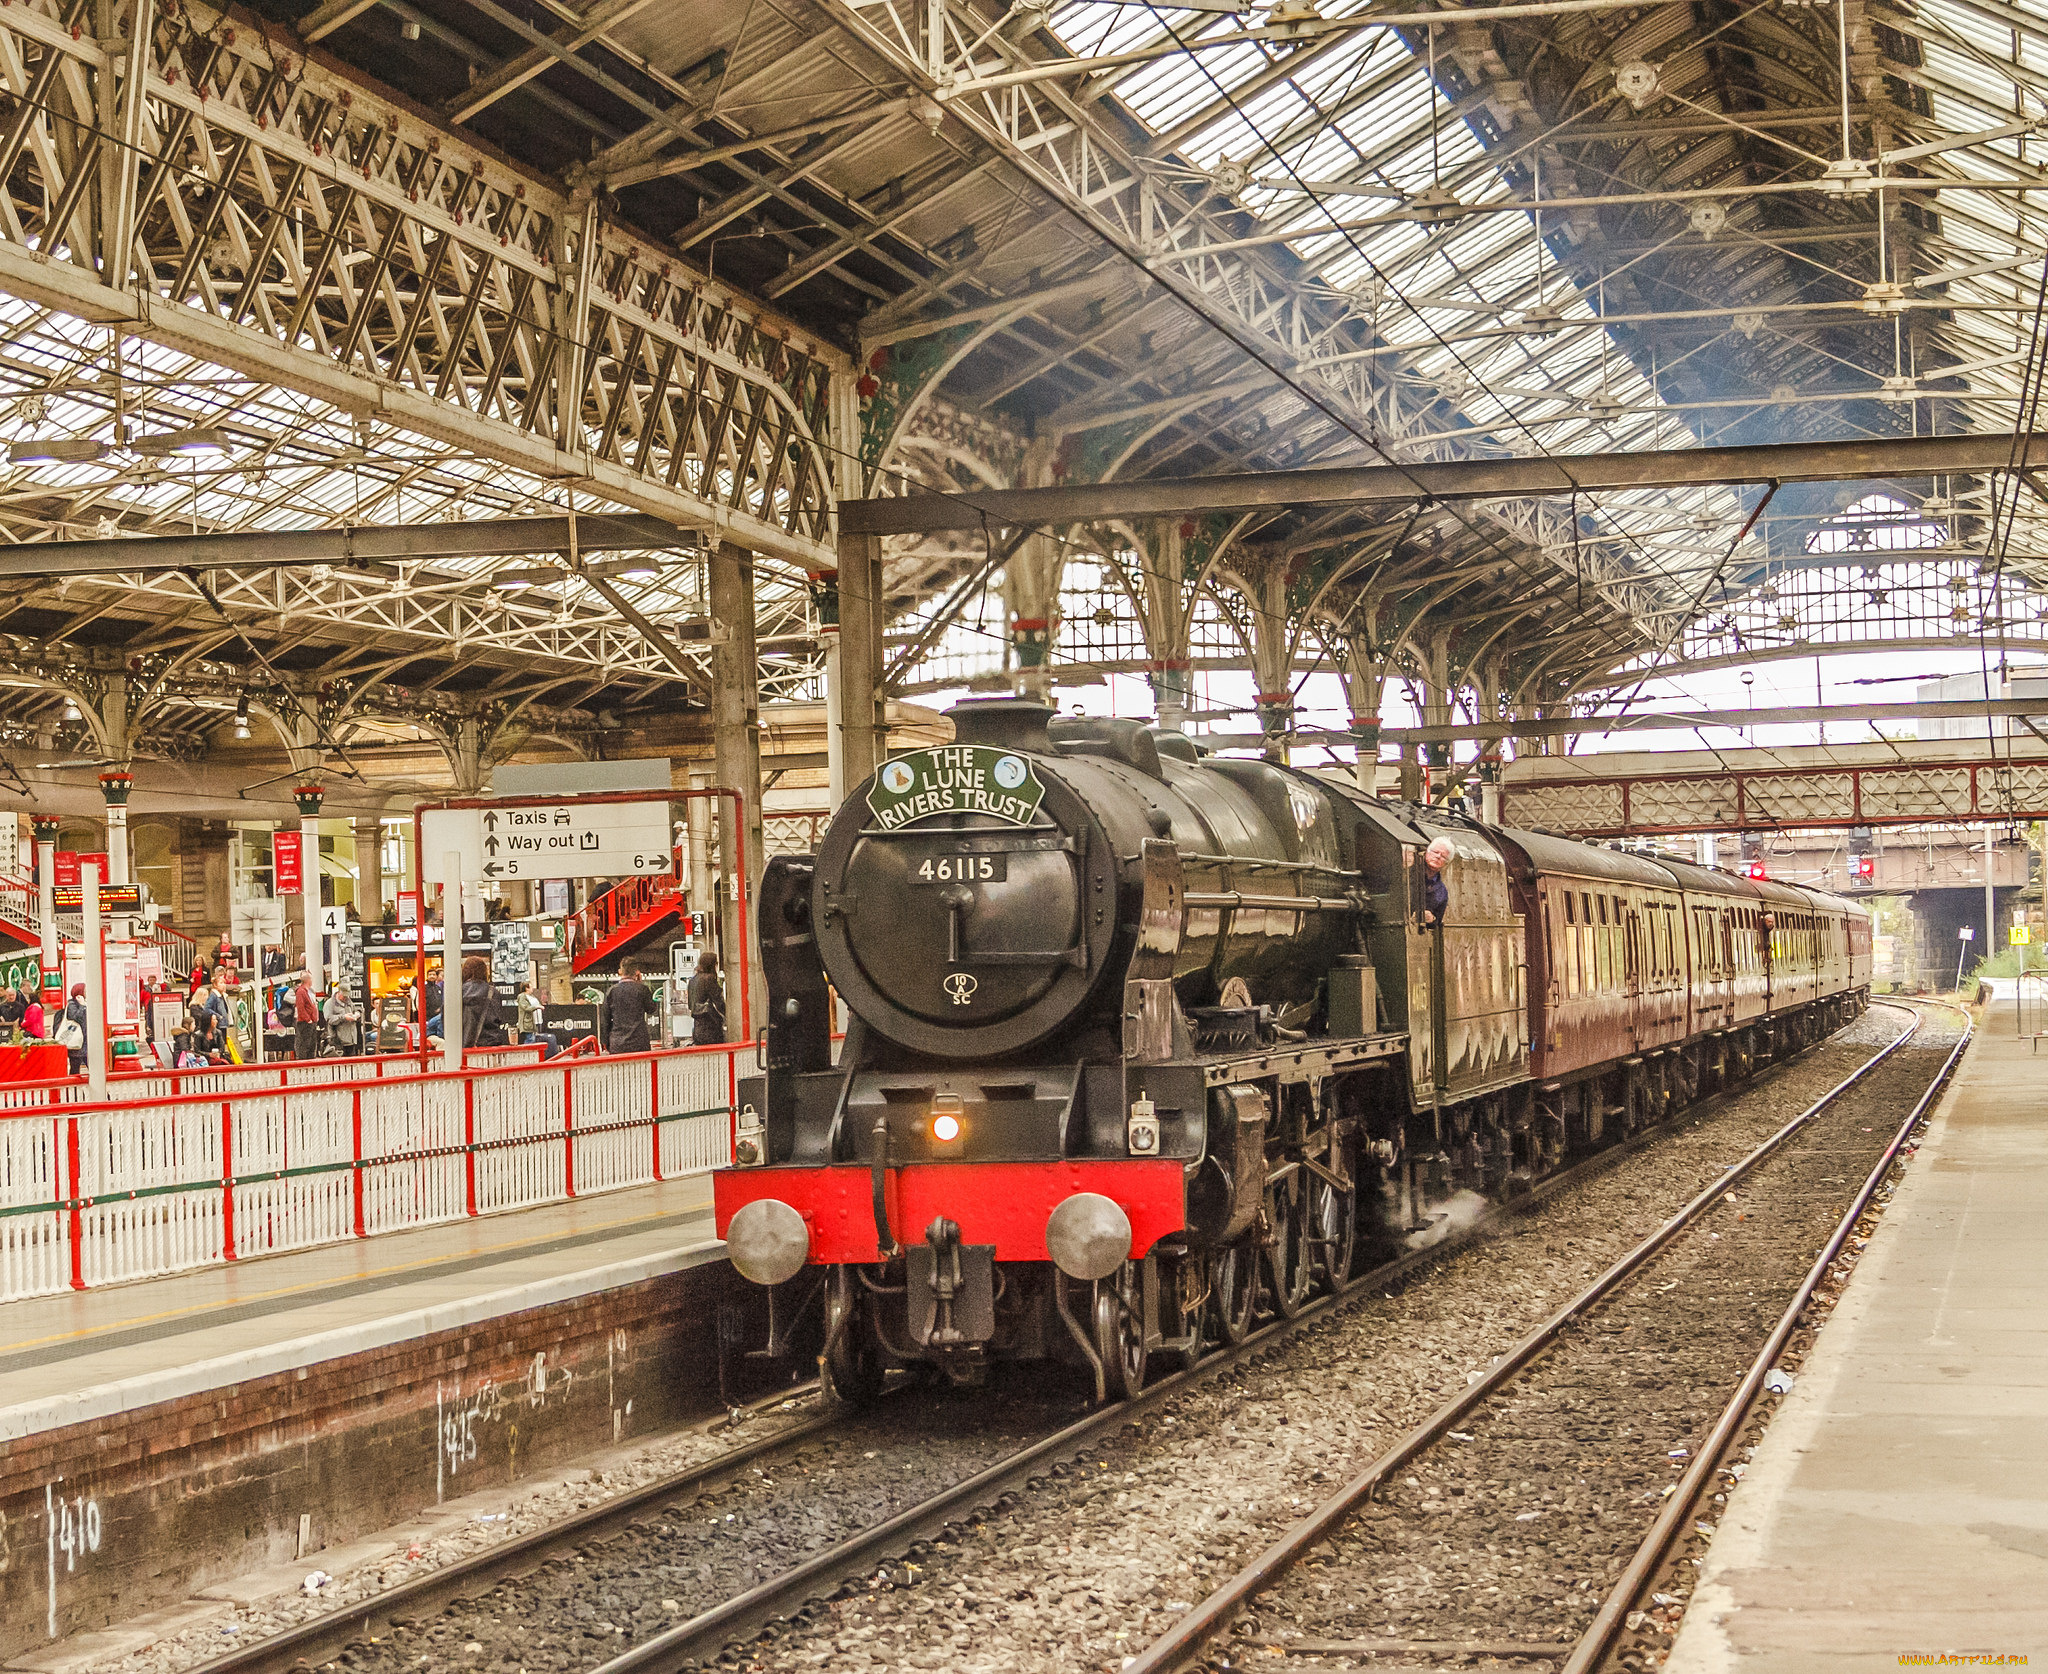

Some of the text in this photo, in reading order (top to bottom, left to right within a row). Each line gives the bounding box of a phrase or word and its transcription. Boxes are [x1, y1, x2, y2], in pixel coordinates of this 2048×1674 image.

[927, 748, 974, 769] THE
[922, 768, 985, 791] LUNE
[879, 788, 1033, 829] RIVERS TRUST
[506, 810, 547, 825] Taxis
[507, 833, 575, 851] Way out
[508, 860, 518, 874] 5
[633, 854, 644, 869] 6
[918, 857, 994, 881] 46115
[325, 911, 337, 930] 4
[693, 914, 702, 924] 3
[693, 923, 703, 933] 4
[2016, 928, 2023, 938] R
[954, 975, 967, 986] 10
[957, 985, 965, 994] A
[953, 994, 971, 1005] SC
[60, 1495, 101, 1572] 410
